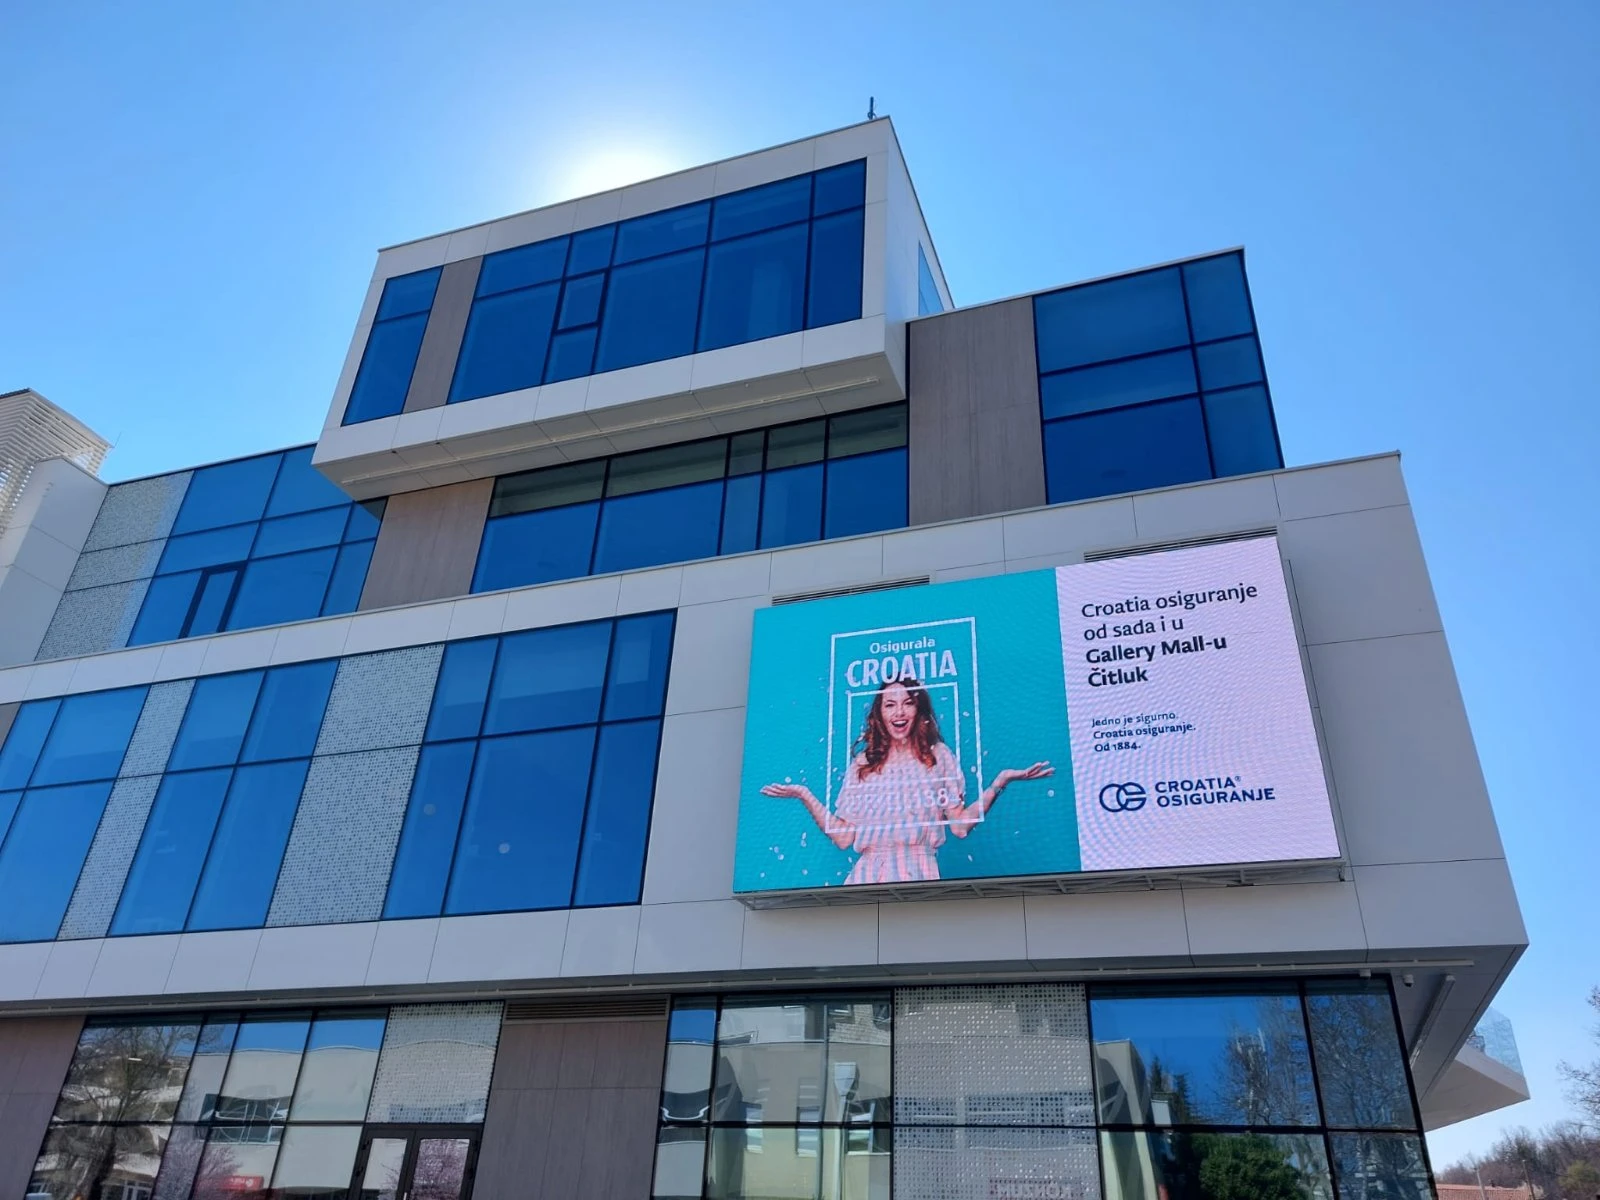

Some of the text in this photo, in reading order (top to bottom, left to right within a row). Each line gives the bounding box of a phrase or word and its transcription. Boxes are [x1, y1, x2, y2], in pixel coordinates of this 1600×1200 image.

[1082, 583, 1257, 618] Croatia osiguranje
[1084, 616, 1184, 640] od sada i u
[870, 637, 936, 654] Osigurala
[1086, 636, 1226, 663] Gallery Mall-u
[846, 650, 957, 688] CROATIA
[1088, 667, 1148, 687] Čitluk
[1093, 721, 1196, 739] Croatia osiguranje.
[1123, 714, 1133, 726] je
[1094, 742, 1142, 752] Od 1884.
[1156, 787, 1275, 807] OSIGURANJE
